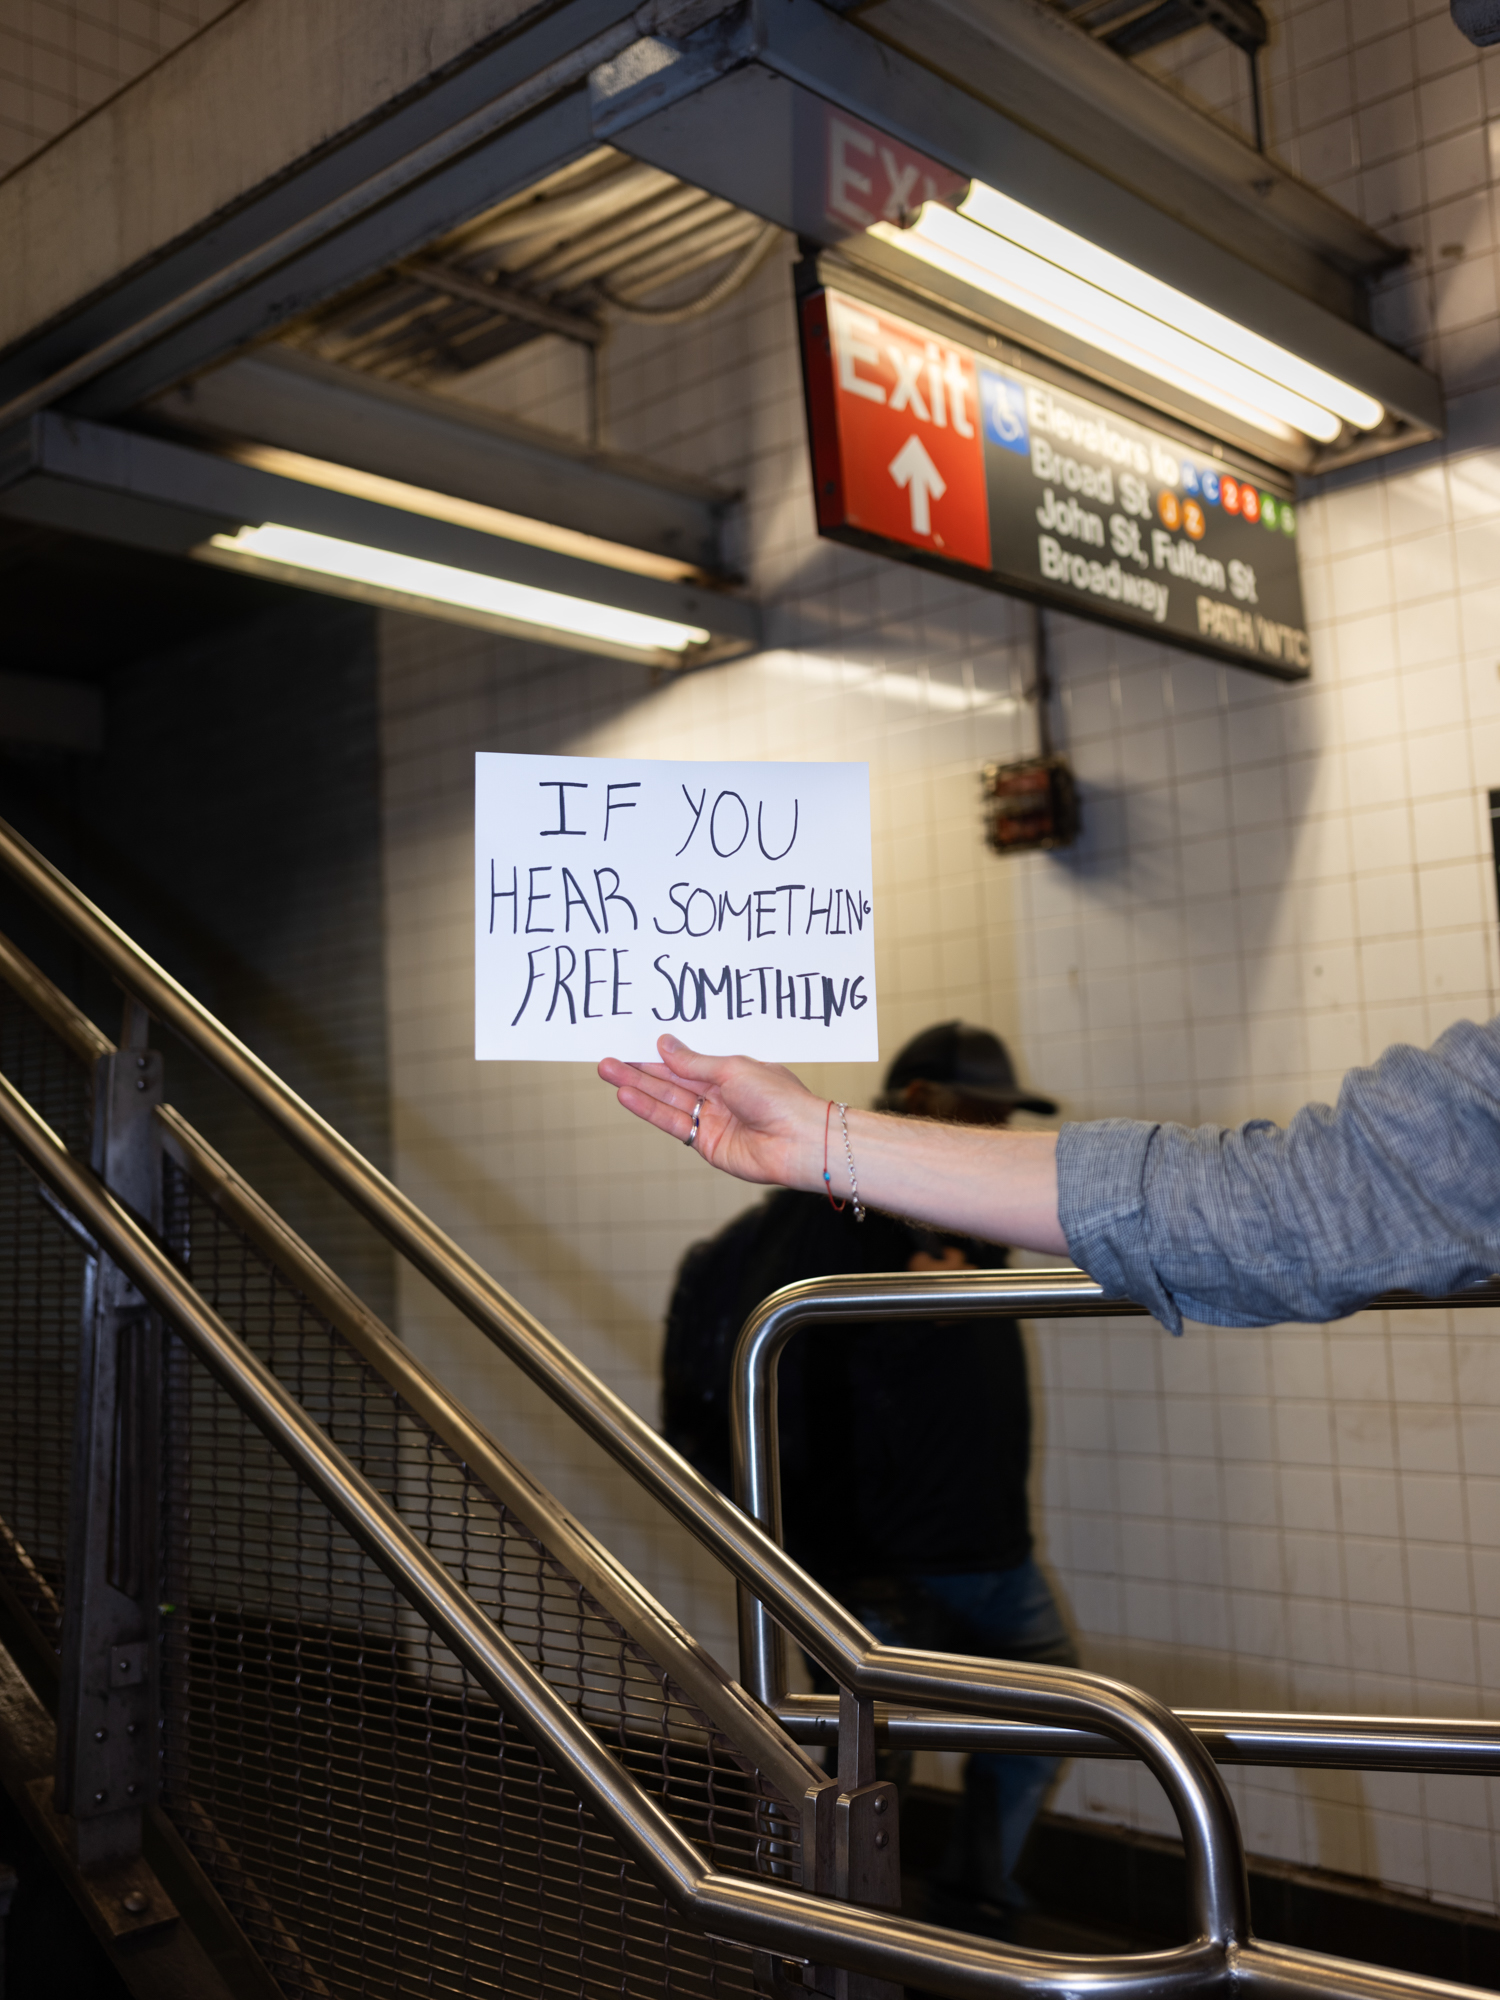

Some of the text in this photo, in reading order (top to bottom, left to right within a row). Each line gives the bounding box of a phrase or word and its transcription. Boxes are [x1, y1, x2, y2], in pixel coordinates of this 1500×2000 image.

[834, 302, 976, 441] Exit
[1030, 435, 1115, 506] Broad
[1118, 472, 1153, 520] St
[1035, 486, 1106, 549] John
[1151, 527, 1226, 593] Fulton
[1227, 558, 1259, 605] St
[1037, 532, 1170, 624] Broadway
[539, 781, 799, 861] IF YOU
[489, 858, 871, 942] HEAR SOMETHING
[510, 945, 869, 1028] FREE SOMETHING
